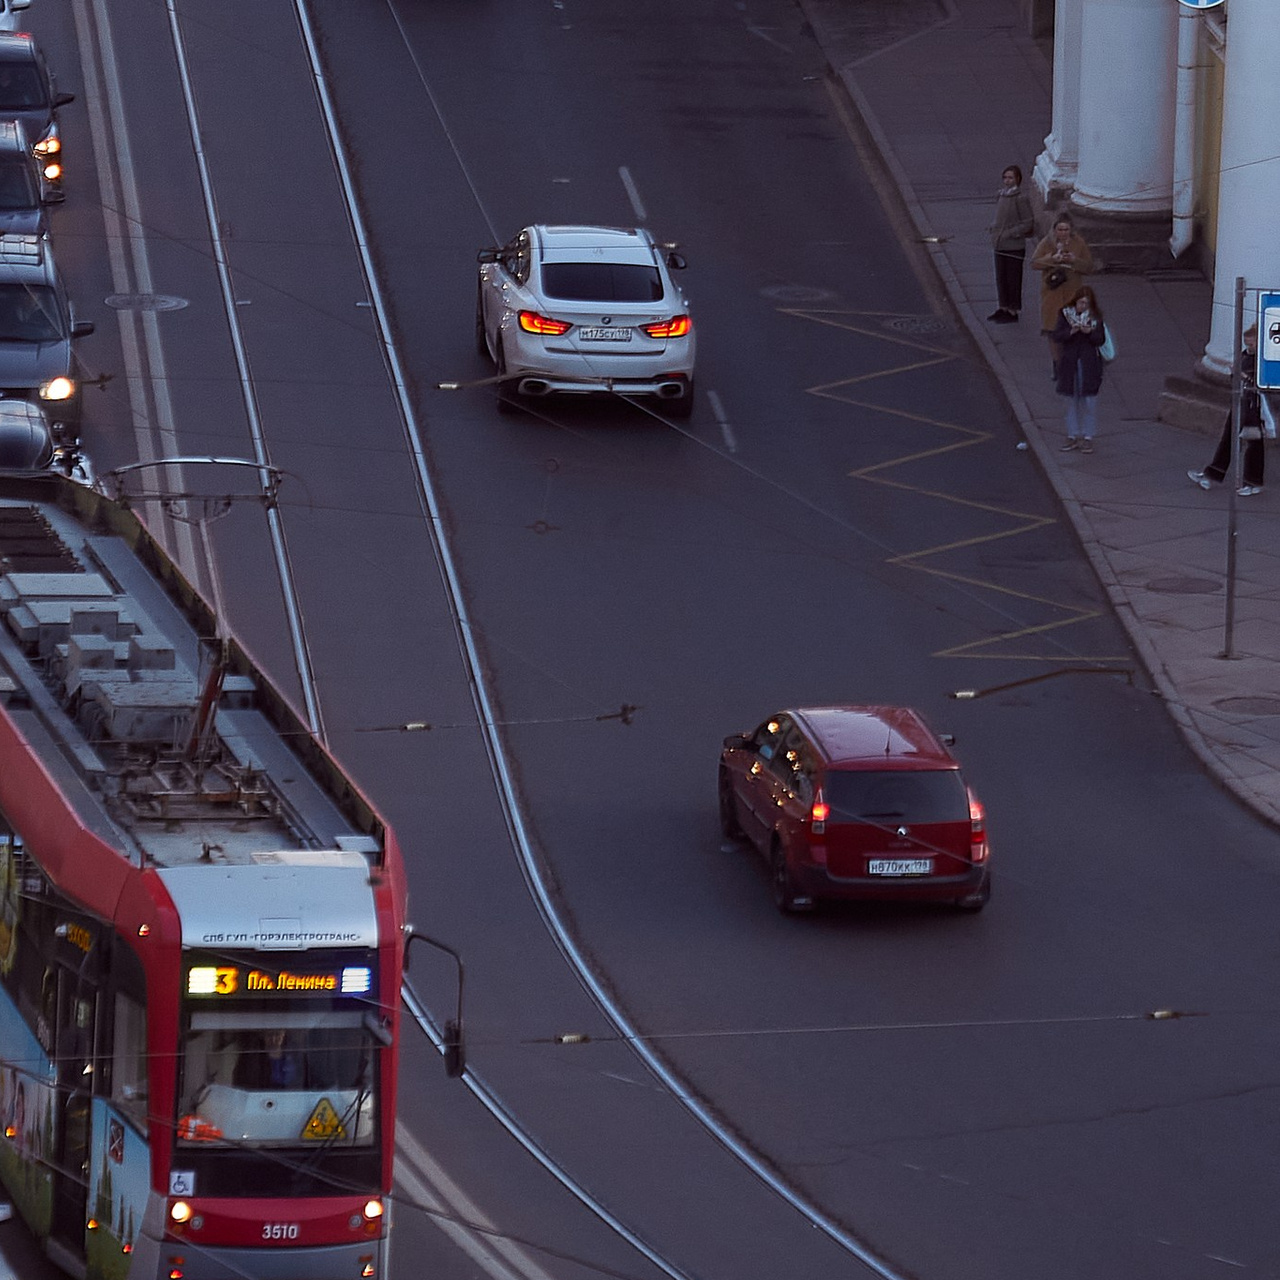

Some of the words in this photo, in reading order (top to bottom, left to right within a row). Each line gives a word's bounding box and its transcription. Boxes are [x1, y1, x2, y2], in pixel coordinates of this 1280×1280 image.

[226, 933, 247, 942] ГУП
[217, 966, 238, 994] 3
[247, 970, 274, 990] Пл.
[277, 970, 337, 990] Ленина
[261, 1224, 298, 1239] 3510
